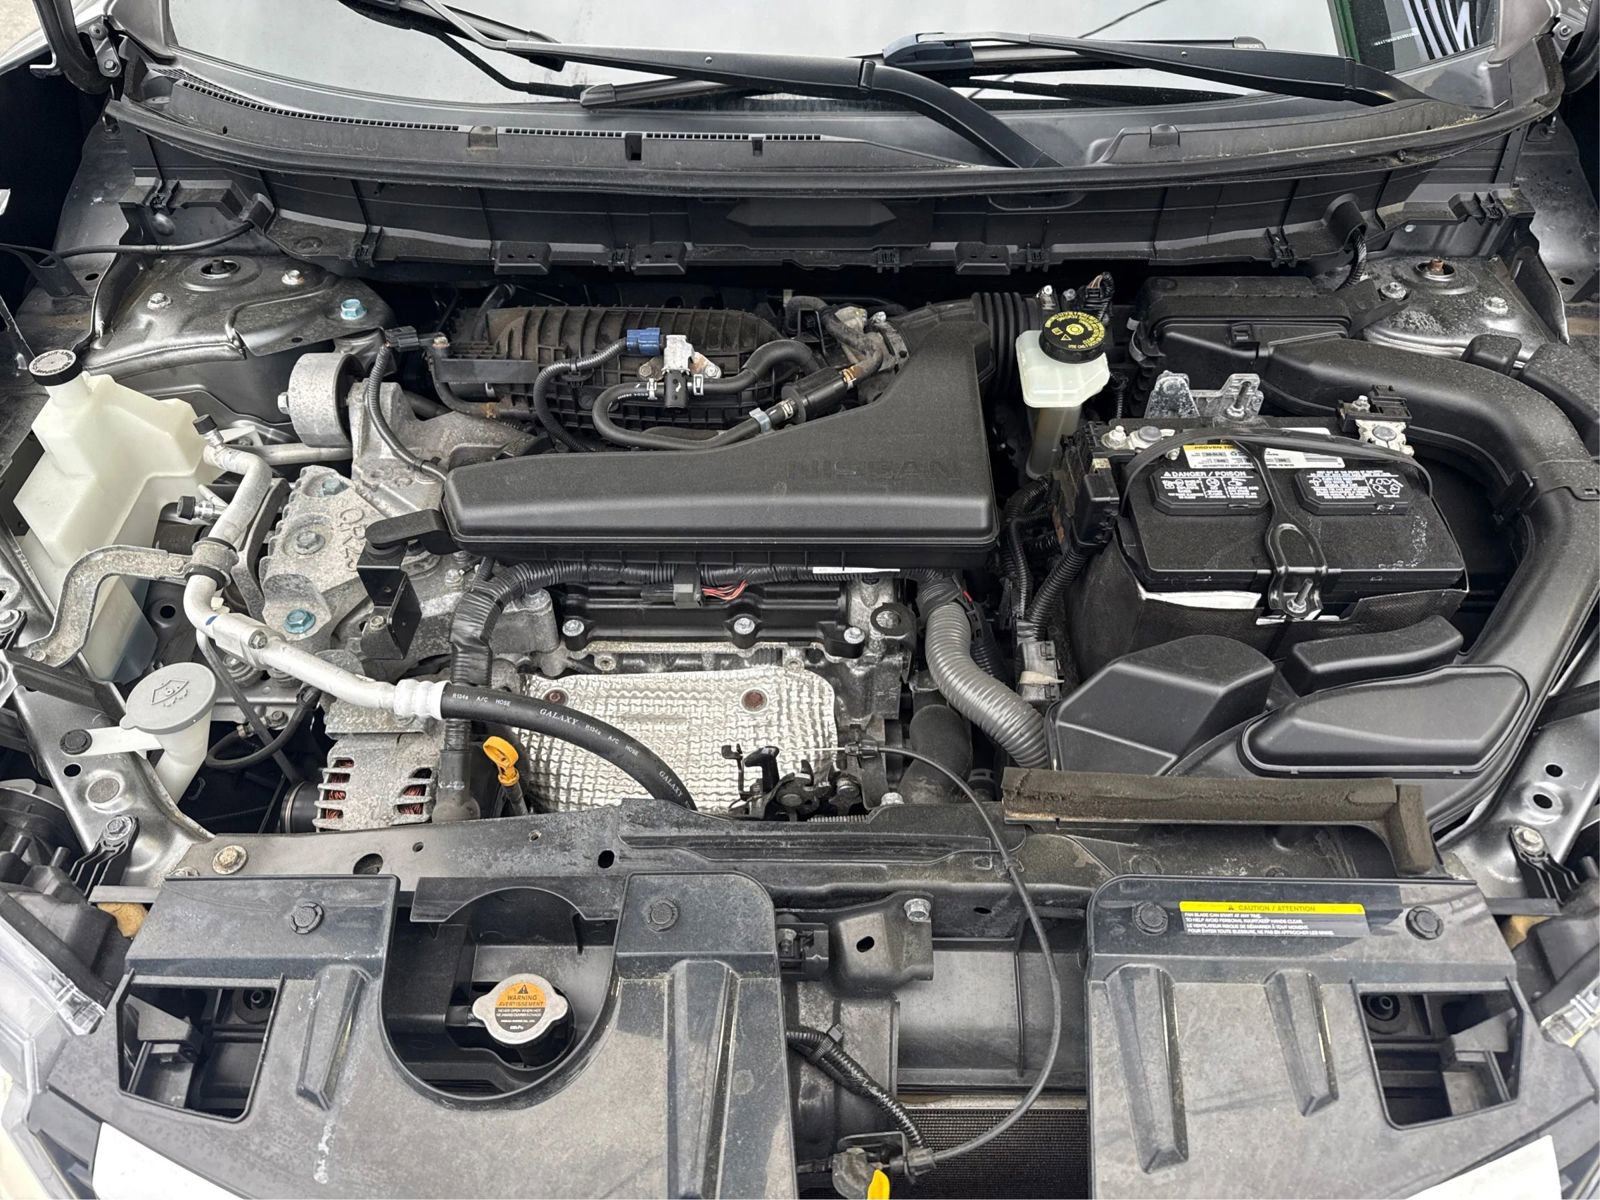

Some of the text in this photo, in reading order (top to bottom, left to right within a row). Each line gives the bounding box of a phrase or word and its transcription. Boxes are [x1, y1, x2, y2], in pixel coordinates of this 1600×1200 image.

[495, 699, 511, 707] HOSE
[540, 708, 578, 725] GALAXY
[608, 735, 620, 744] A/C
[624, 745, 640, 756] HOSE
[658, 770, 683, 797] GALAXY
[1238, 904, 1270, 912] CAUTION
